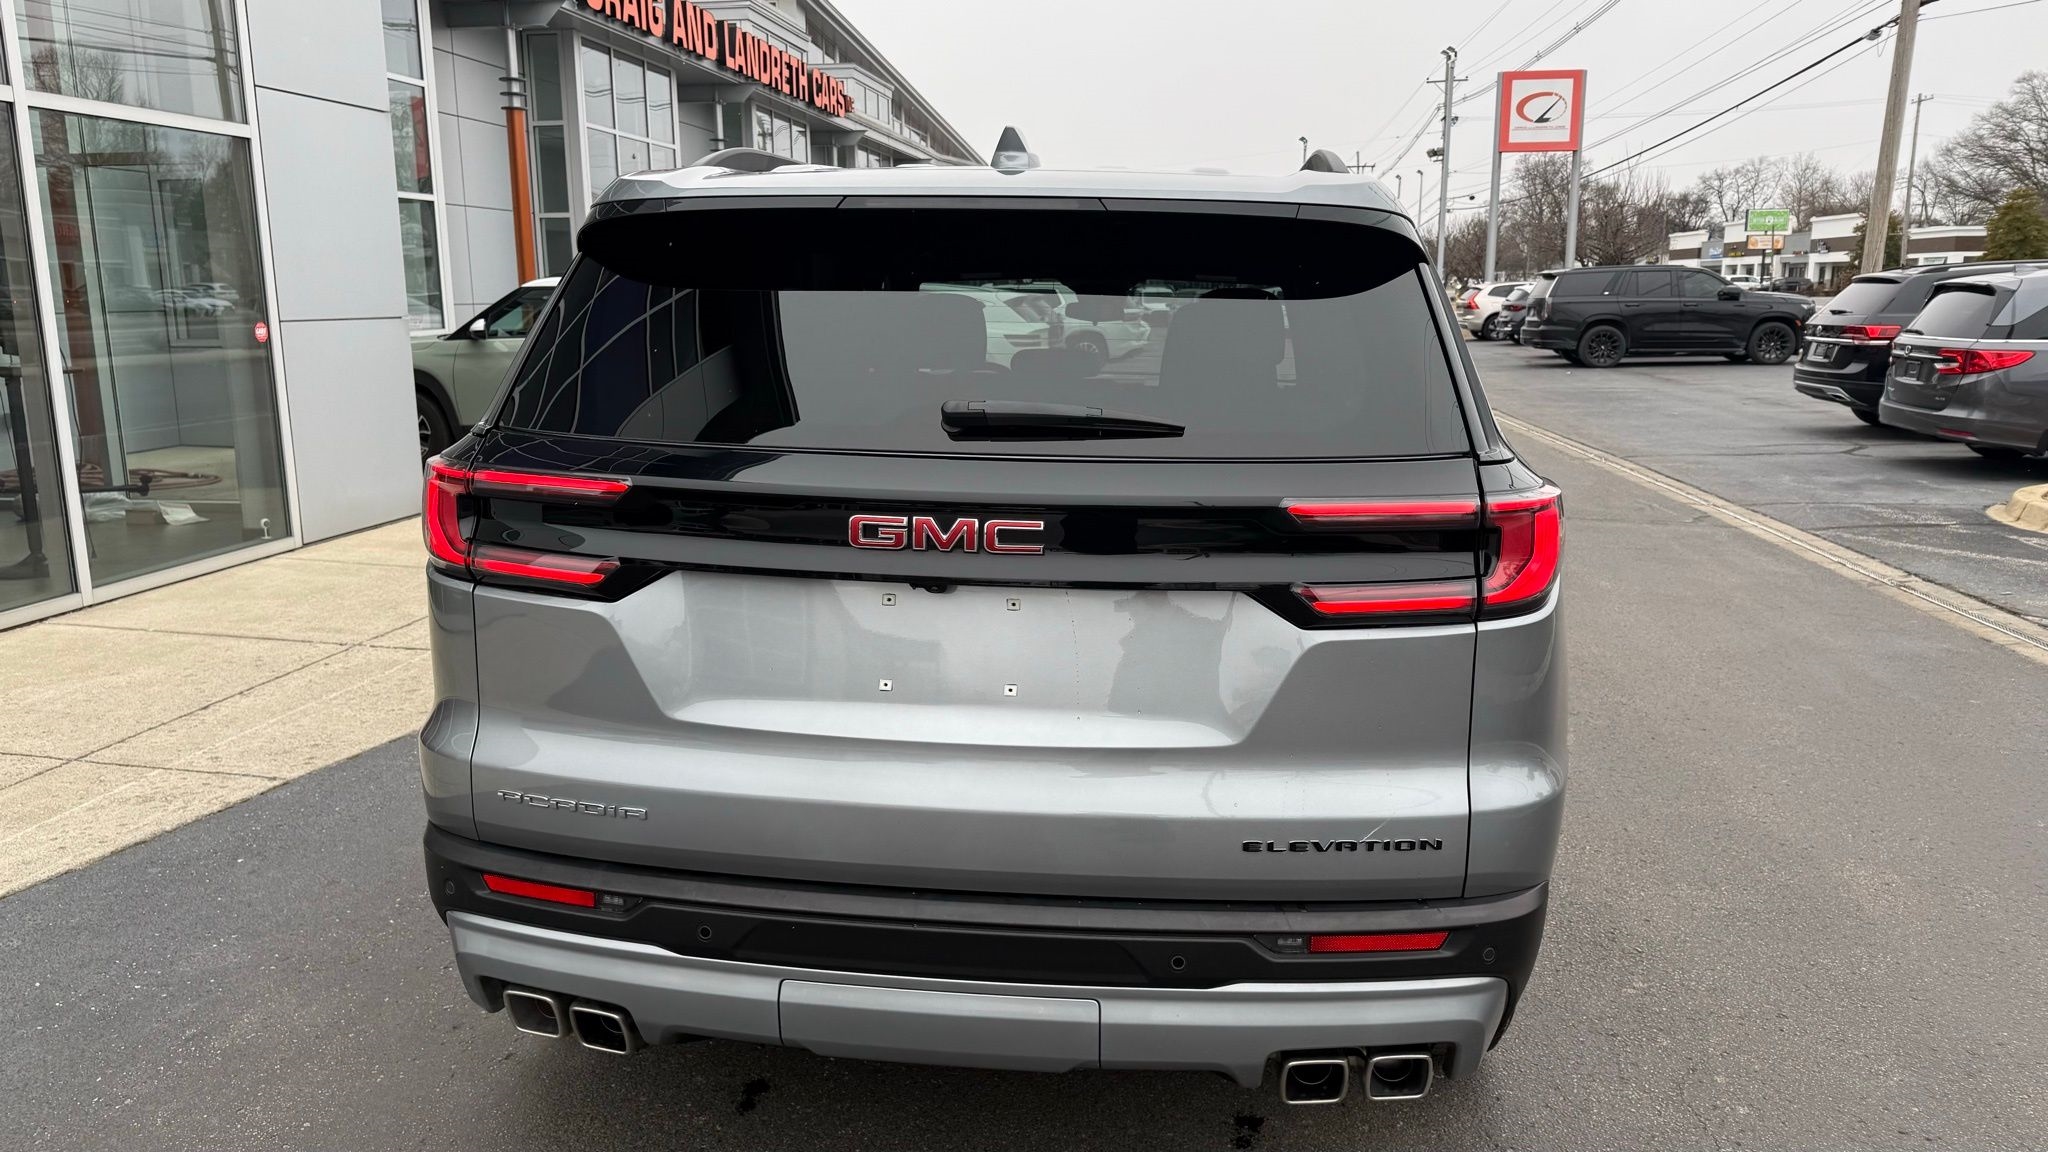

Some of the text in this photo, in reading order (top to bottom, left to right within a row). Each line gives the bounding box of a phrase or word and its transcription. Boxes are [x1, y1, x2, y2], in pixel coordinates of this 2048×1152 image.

[586, 0, 846, 118] AIG AND LANDRETH CARS
[848, 514, 1045, 555] GMC
[497, 789, 649, 821] ACADIA
[1241, 838, 1444, 853] ELEVATION
